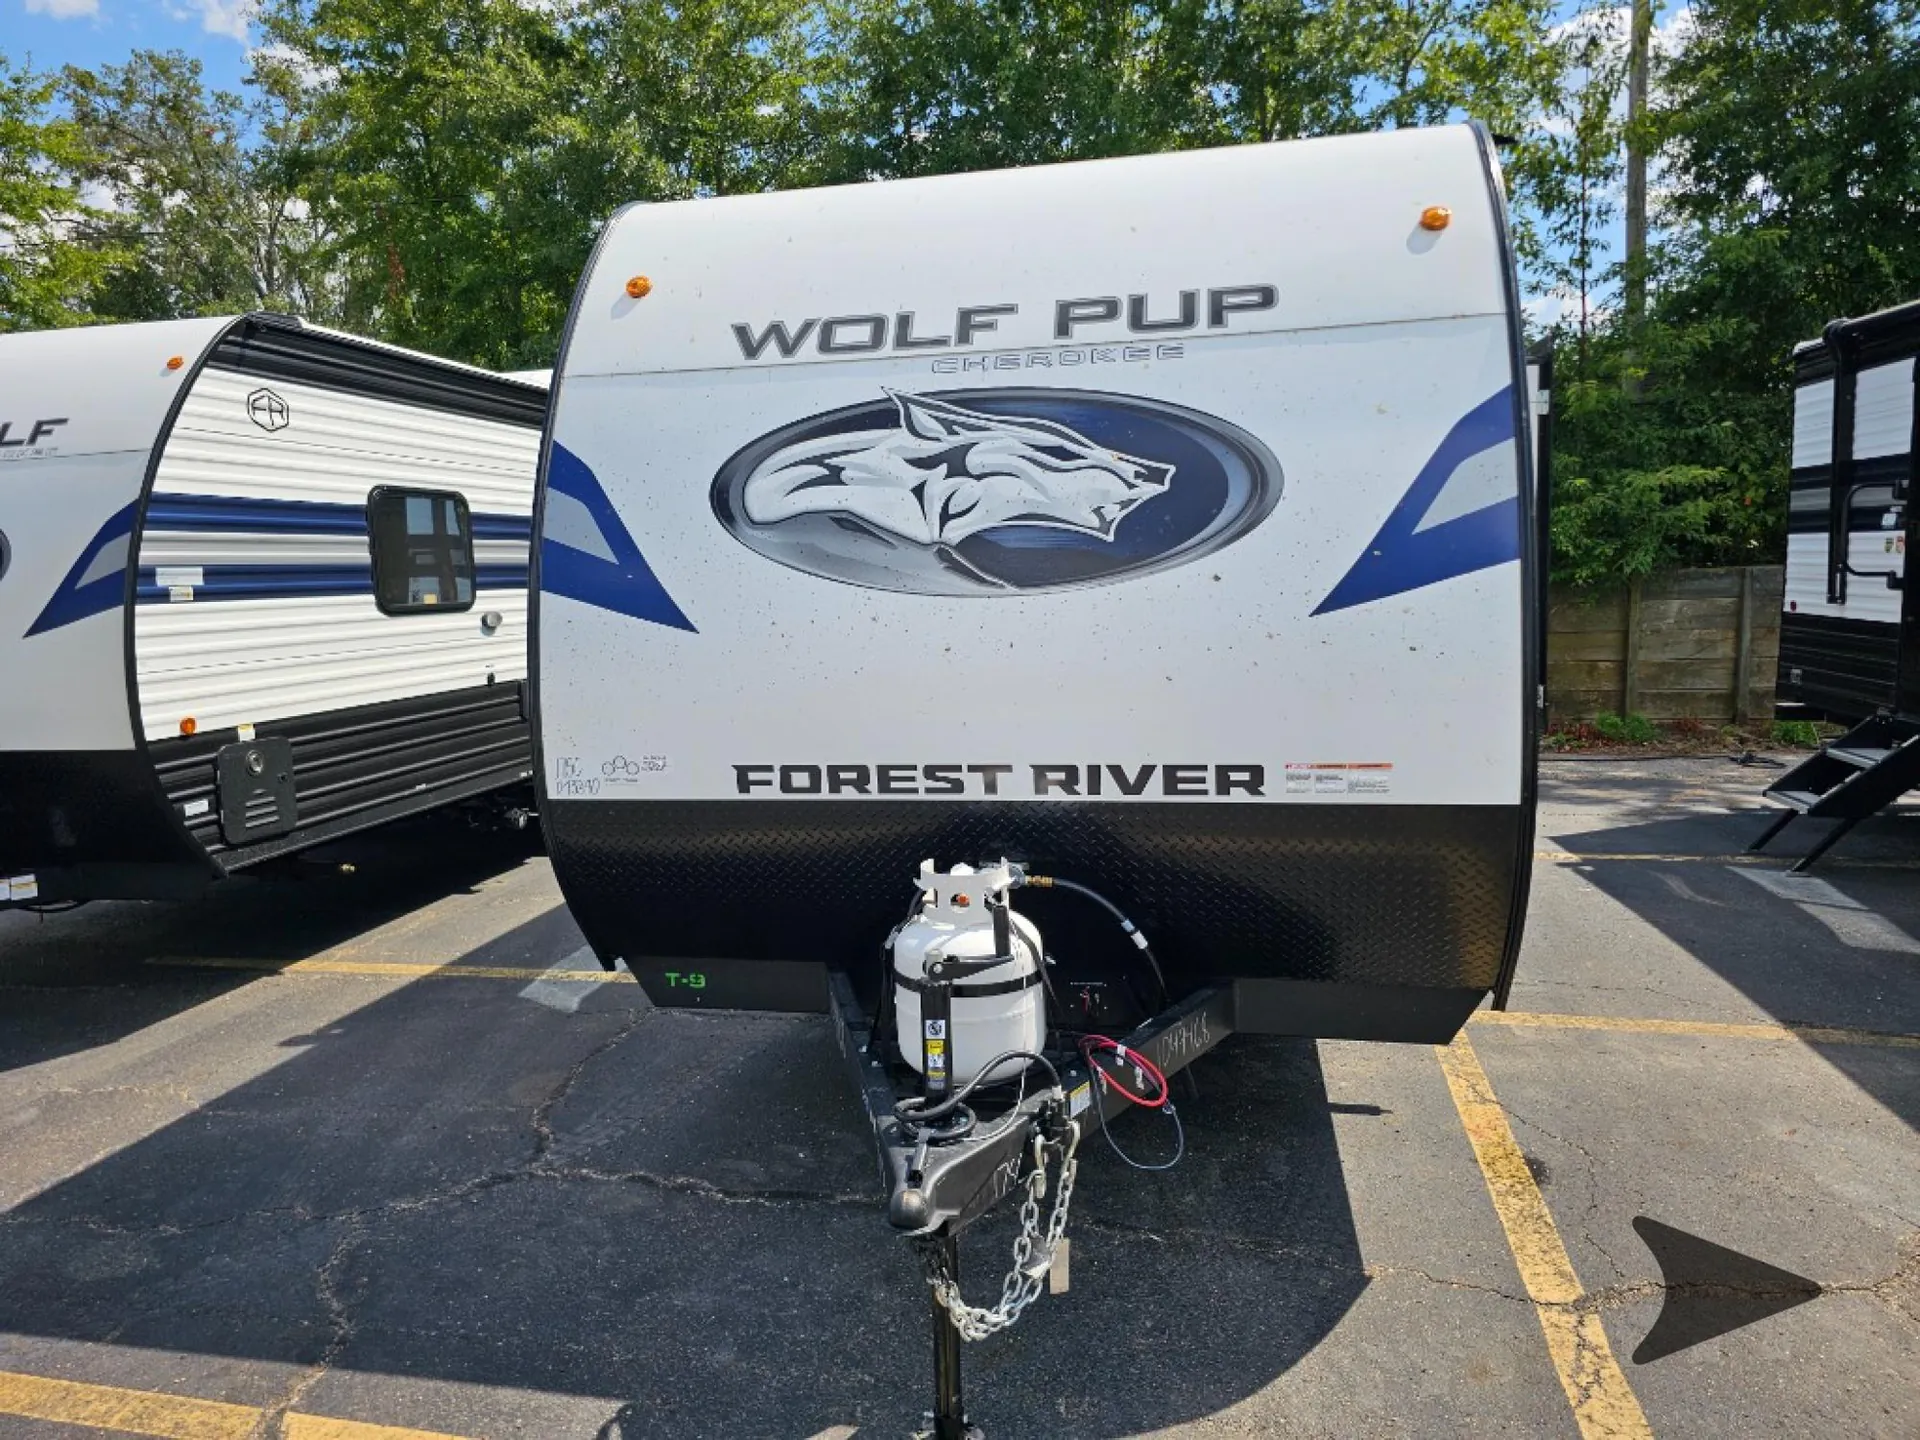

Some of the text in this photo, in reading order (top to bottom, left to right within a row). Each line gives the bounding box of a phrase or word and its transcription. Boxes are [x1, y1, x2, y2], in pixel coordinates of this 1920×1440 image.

[730, 283, 1279, 361] WOLF PUP
[930, 342, 1185, 374] CHEROKEE
[731, 763, 1013, 796] FOREST
[1028, 763, 1267, 797] RIVER
[664, 972, 706, 988] T-9
